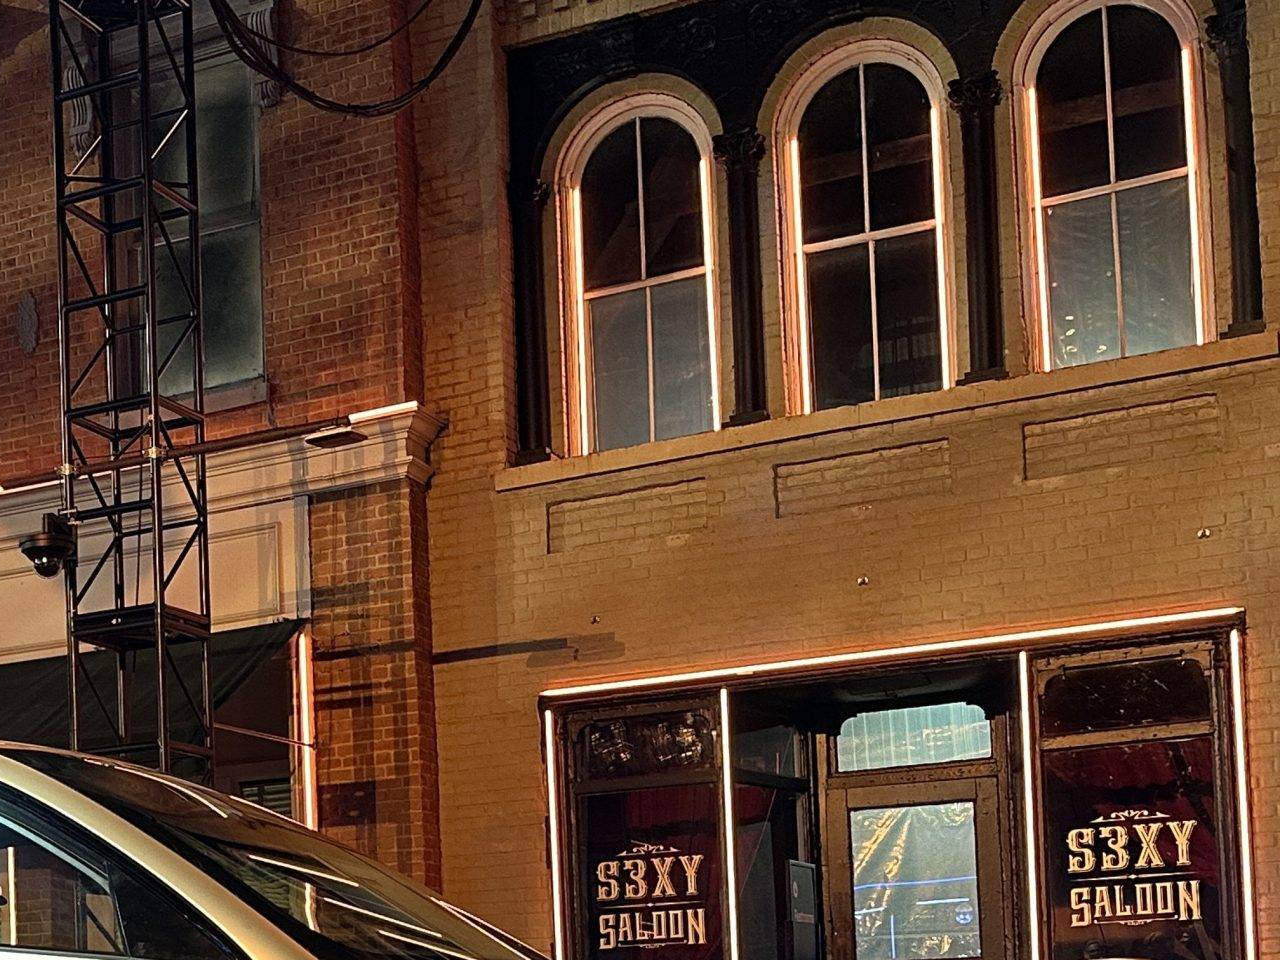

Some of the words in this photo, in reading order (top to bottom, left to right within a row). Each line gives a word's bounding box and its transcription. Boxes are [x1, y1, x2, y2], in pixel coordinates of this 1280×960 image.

[1066, 820, 1197, 874] S3XY
[596, 855, 704, 901] S3XY
[1070, 880, 1202, 928] SALOON
[598, 908, 707, 950] SALOON
